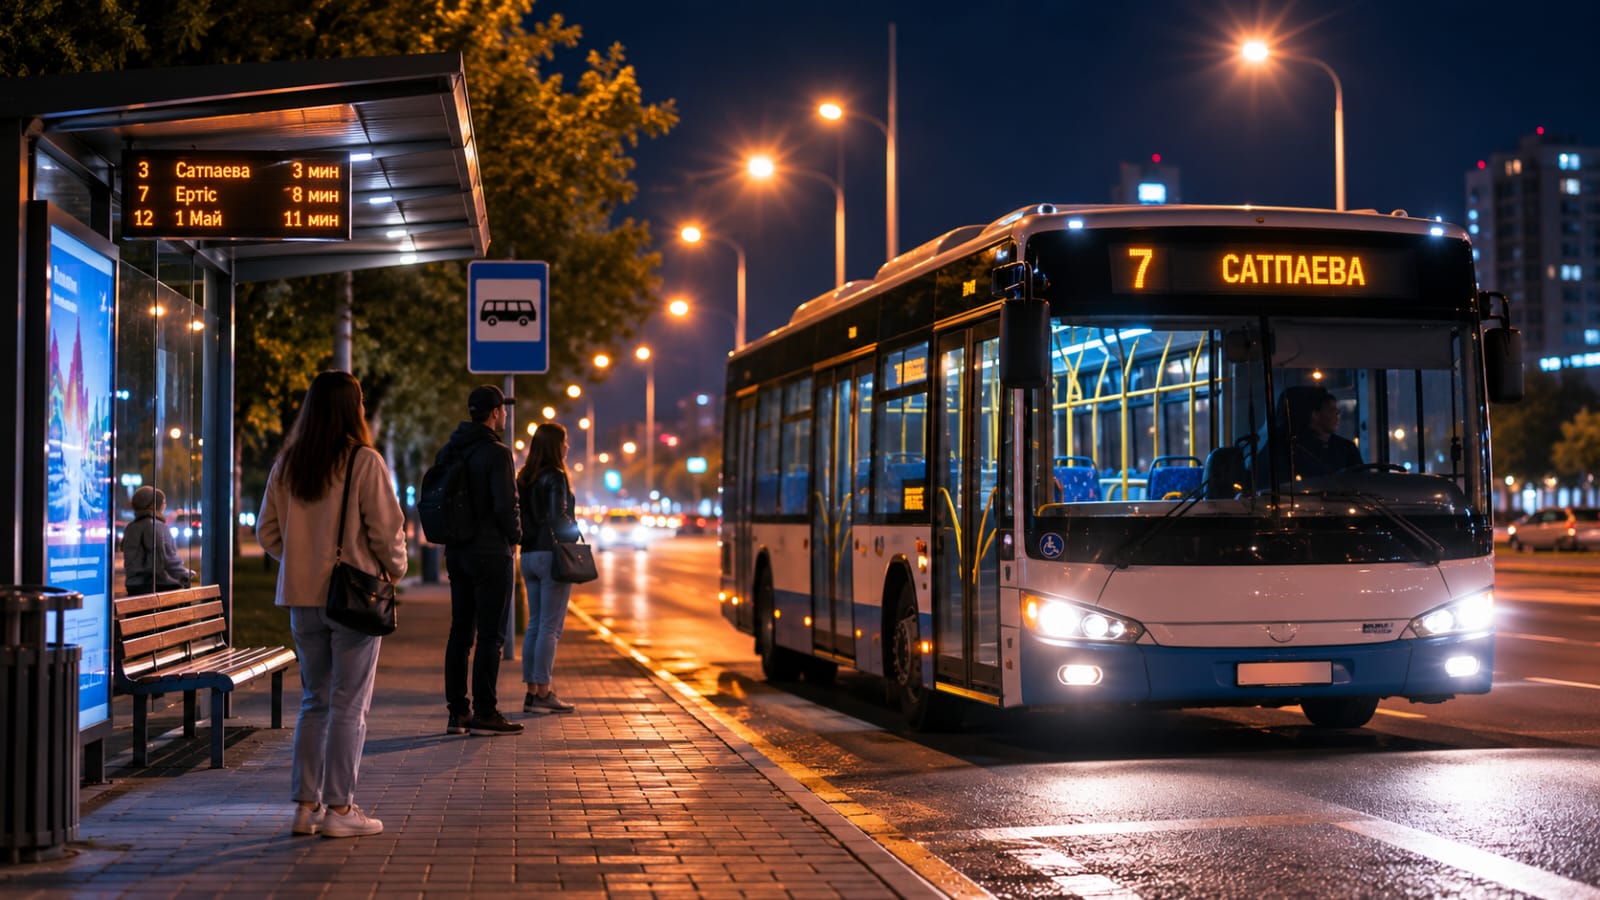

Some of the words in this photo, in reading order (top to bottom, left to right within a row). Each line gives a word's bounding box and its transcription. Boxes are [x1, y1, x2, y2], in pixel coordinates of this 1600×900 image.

[138, 160, 149, 178] 3
[175, 161, 250, 178] Сатпаева
[293, 161, 303, 179] 3
[308, 165, 339, 179] мин
[138, 185, 149, 202] 7
[175, 185, 217, 206] Ертіс
[292, 186, 303, 203] 8
[308, 190, 339, 203] мин
[134, 209, 153, 226] 12
[175, 209, 184, 226] 1
[189, 209, 222, 226] Май
[284, 210, 302, 227] 11
[308, 213, 339, 227] мин
[1129, 247, 1153, 289] 7
[1222, 254, 1366, 286] САТПАЕВА
